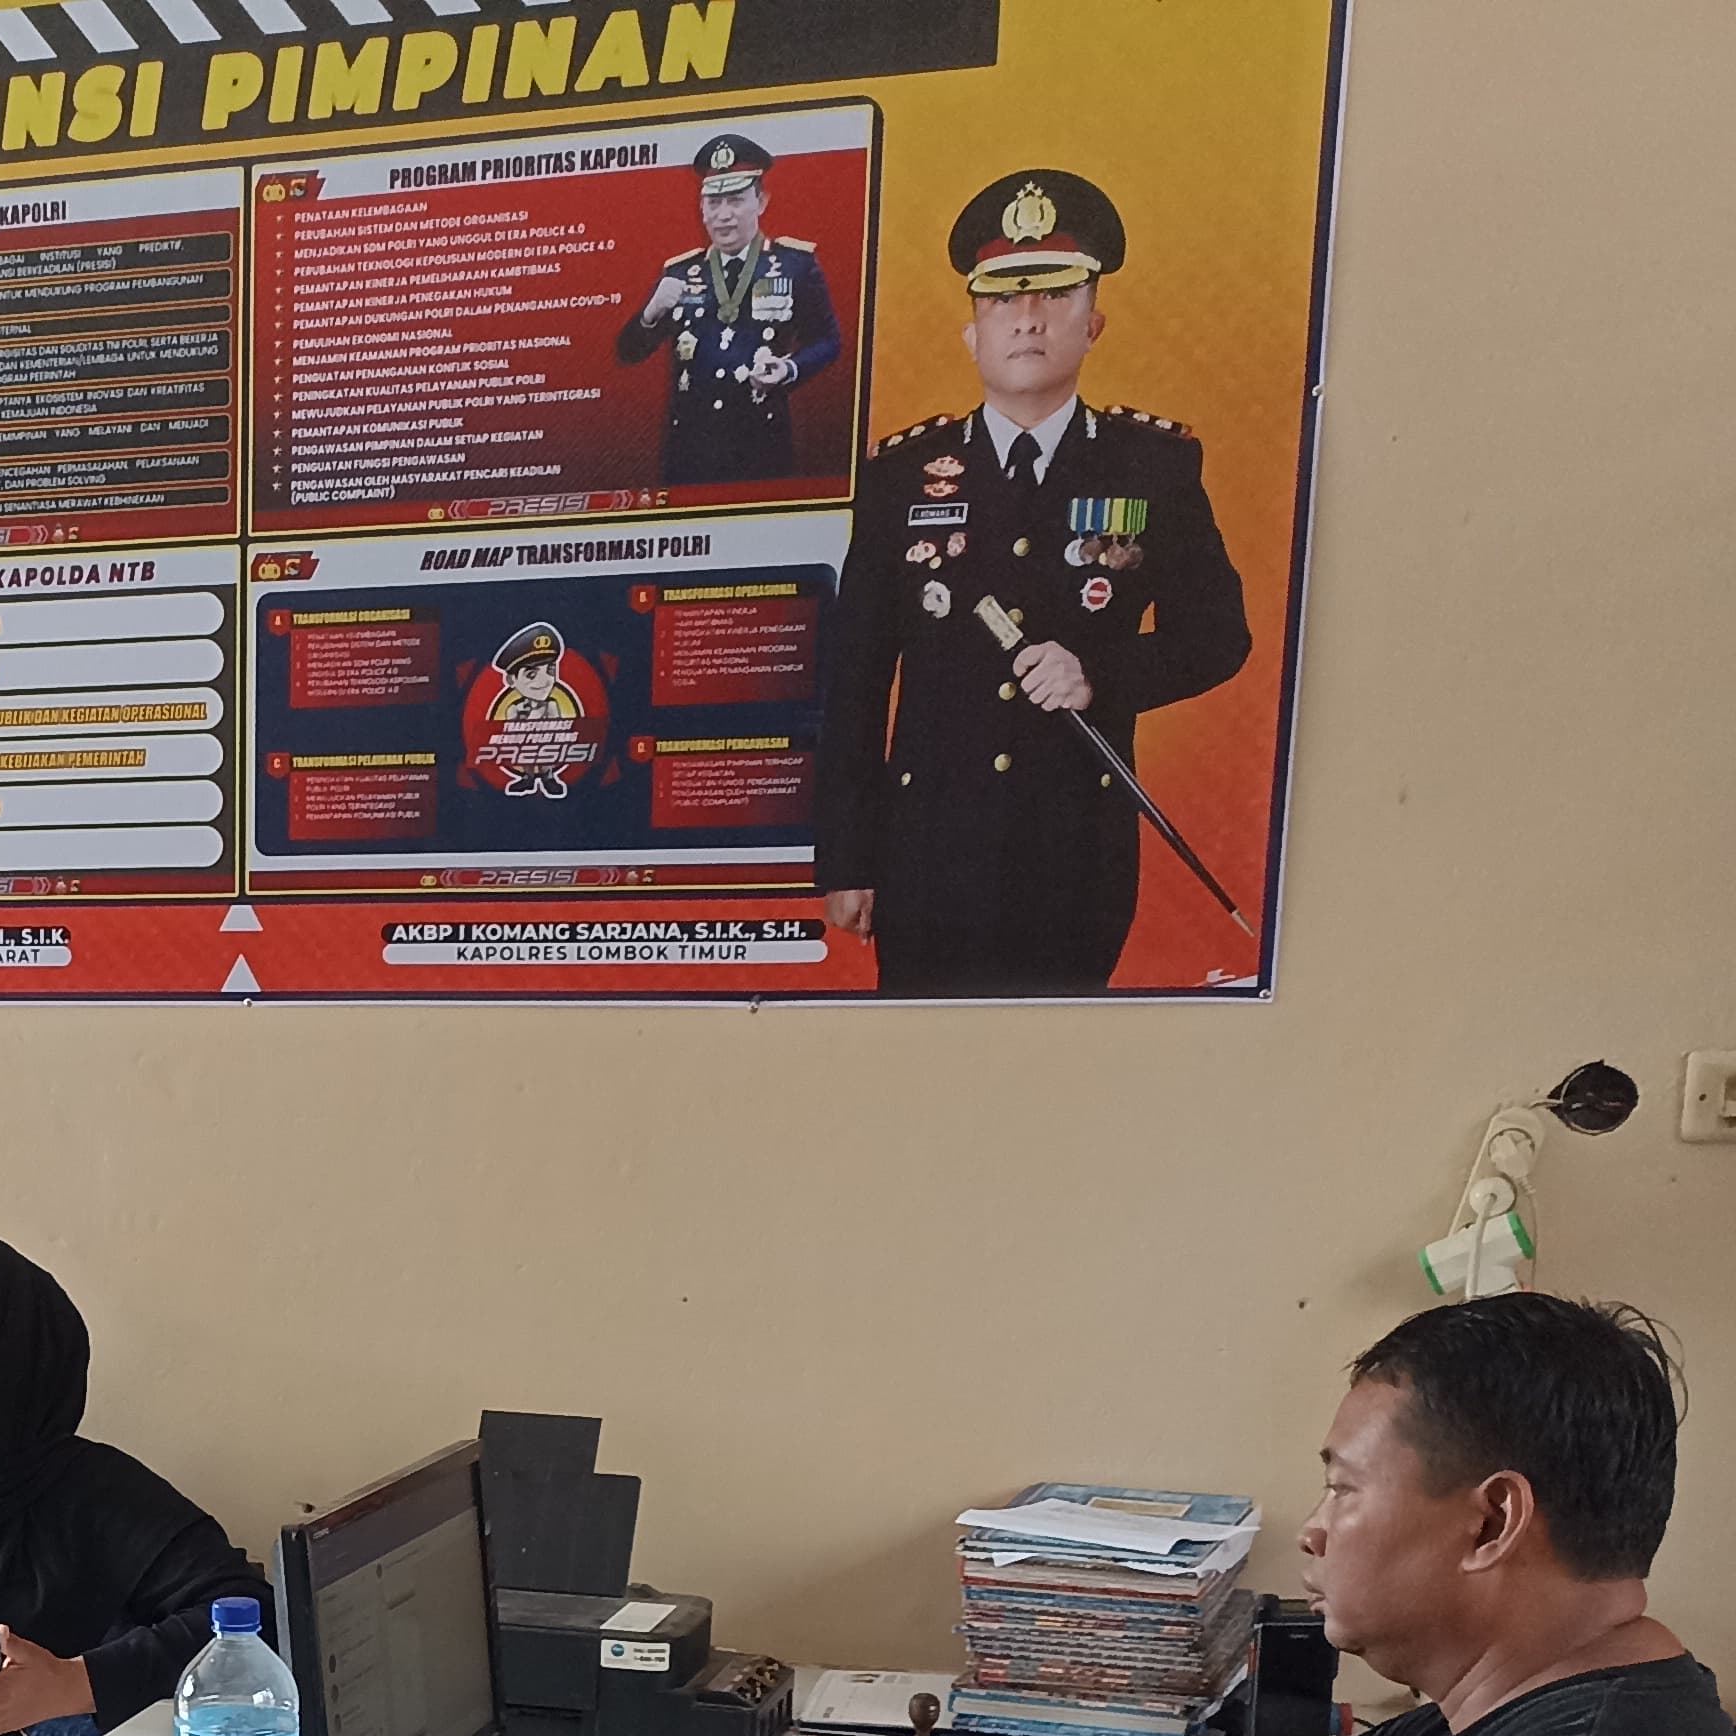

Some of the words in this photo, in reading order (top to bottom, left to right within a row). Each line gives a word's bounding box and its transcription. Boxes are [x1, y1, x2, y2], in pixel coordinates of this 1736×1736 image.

[202, 1, 735, 130] PIMPINAN
[390, 163, 475, 189] PROGRAM
[481, 153, 575, 180] PRIORITAS
[579, 143, 658, 170] KAPOLRI
[0, 200, 67, 227] KAPOLRI
[294, 209, 349, 221] PENATAAN
[350, 203, 427, 217] KELEMBAGAAN
[294, 226, 355, 240] PERUBAHAN
[357, 223, 393, 234] SISTEM
[394, 220, 417, 231] DAN
[419, 217, 460, 229] METODE
[463, 211, 528, 225] ORGANISASI
[294, 243, 361, 258] MENJADIKAN
[363, 241, 385, 252] SDM
[387, 238, 416, 250] POLRI
[418, 236, 448, 247] YANG
[449, 232, 491, 245] UNGGUL
[494, 231, 505, 241] DI
[507, 229, 527, 240] ERA
[529, 226, 564, 238] POLICE
[567, 224, 584, 235] 4.0
[293, 261, 355, 275] PERUBAHAN
[357, 256, 413, 270] TEKNOLOGI
[415, 251, 475, 265] KEPOLISIAN
[476, 247, 522, 260] MODERN
[523, 246, 534, 257] DI
[536, 245, 556, 255] ERA
[558, 242, 594, 254] POLICE
[597, 240, 614, 250] 4.0
[293, 297, 362, 311] PEMANTAPAN
[364, 294, 407, 306] KINERJA
[408, 289, 471, 303] PENEGAKAN
[473, 286, 512, 298] HUKUM
[293, 314, 362, 329] PEMANTAPAN
[364, 310, 422, 323] DUKUNGAN
[424, 307, 453, 318] POLRI
[455, 304, 492, 316] DALAM
[493, 298, 568, 313] PENANGANAN
[569, 294, 621, 307] COVID-19
[292, 335, 350, 348] PEMULIHAN
[351, 332, 399, 344] EKONOMI
[400, 328, 452, 340] NASIONAL
[292, 352, 347, 365] MENJAMIN
[348, 348, 407, 361] KEAMANAN
[408, 344, 461, 356] PROGRAM
[462, 340, 516, 353] PRIORITAS
[518, 336, 570, 349] NASIONAL
[292, 369, 354, 382] PENGUATAN
[355, 364, 426, 378] PENANGANAN
[428, 361, 470, 373] KONFLIK
[473, 359, 508, 370] SOSIAL
[292, 386, 363, 400] PENINGKATAN
[365, 383, 413, 395] KUALITAS
[415, 379, 476, 392] PELAYANAN
[478, 376, 513, 387] PUBLIK
[515, 374, 545, 385] POLRI
[291, 424, 360, 437] PEMANTAPAN
[362, 420, 427, 432] KOMUNIKASI
[428, 417, 462, 428] PUBLIK
[291, 460, 352, 472] PENGUATAN
[353, 457, 390, 468] FUNGSI
[391, 453, 465, 466] PENGAWASAN
[290, 476, 362, 489] PENGAWASAN
[363, 475, 389, 485] OLEH
[390, 471, 462, 484] MASYARAKAT
[463, 468, 508, 479] PENCARI
[509, 465, 560, 476] KEADILAN
[290, 490, 329, 503] (PUBLIC
[331, 486, 395, 501] COMPLAINT)
[488, 495, 590, 516] PRESISI
[420, 549, 470, 570] ROAD
[471, 546, 514, 568] MAP
[516, 538, 654, 566] TRANSFORMASI
[657, 535, 711, 558] POLRI
[109, 561, 156, 583] NTB
[32, 707, 59, 726] DAN
[60, 705, 121, 724] KEGIATAN
[121, 702, 207, 723] OPERASIONAL
[0, 751, 66, 771] KEBIJAKAN
[68, 749, 146, 768] PEMERINTAH
[475, 743, 598, 765] PRESISI
[478, 870, 577, 886] PRESISI
[21, 928, 69, 945] S.I.K.
[391, 924, 454, 942] AKBP
[459, 924, 465, 941] I
[470, 923, 569, 941] KOMANG
[576, 922, 689, 943] SARJANA,
[694, 922, 756, 942] S.I.K.,
[763, 921, 807, 938] S.H.
[456, 945, 567, 961] KAPOLRES
[577, 945, 673, 961] LOMBOK
[680, 944, 747, 960] TIMUR
